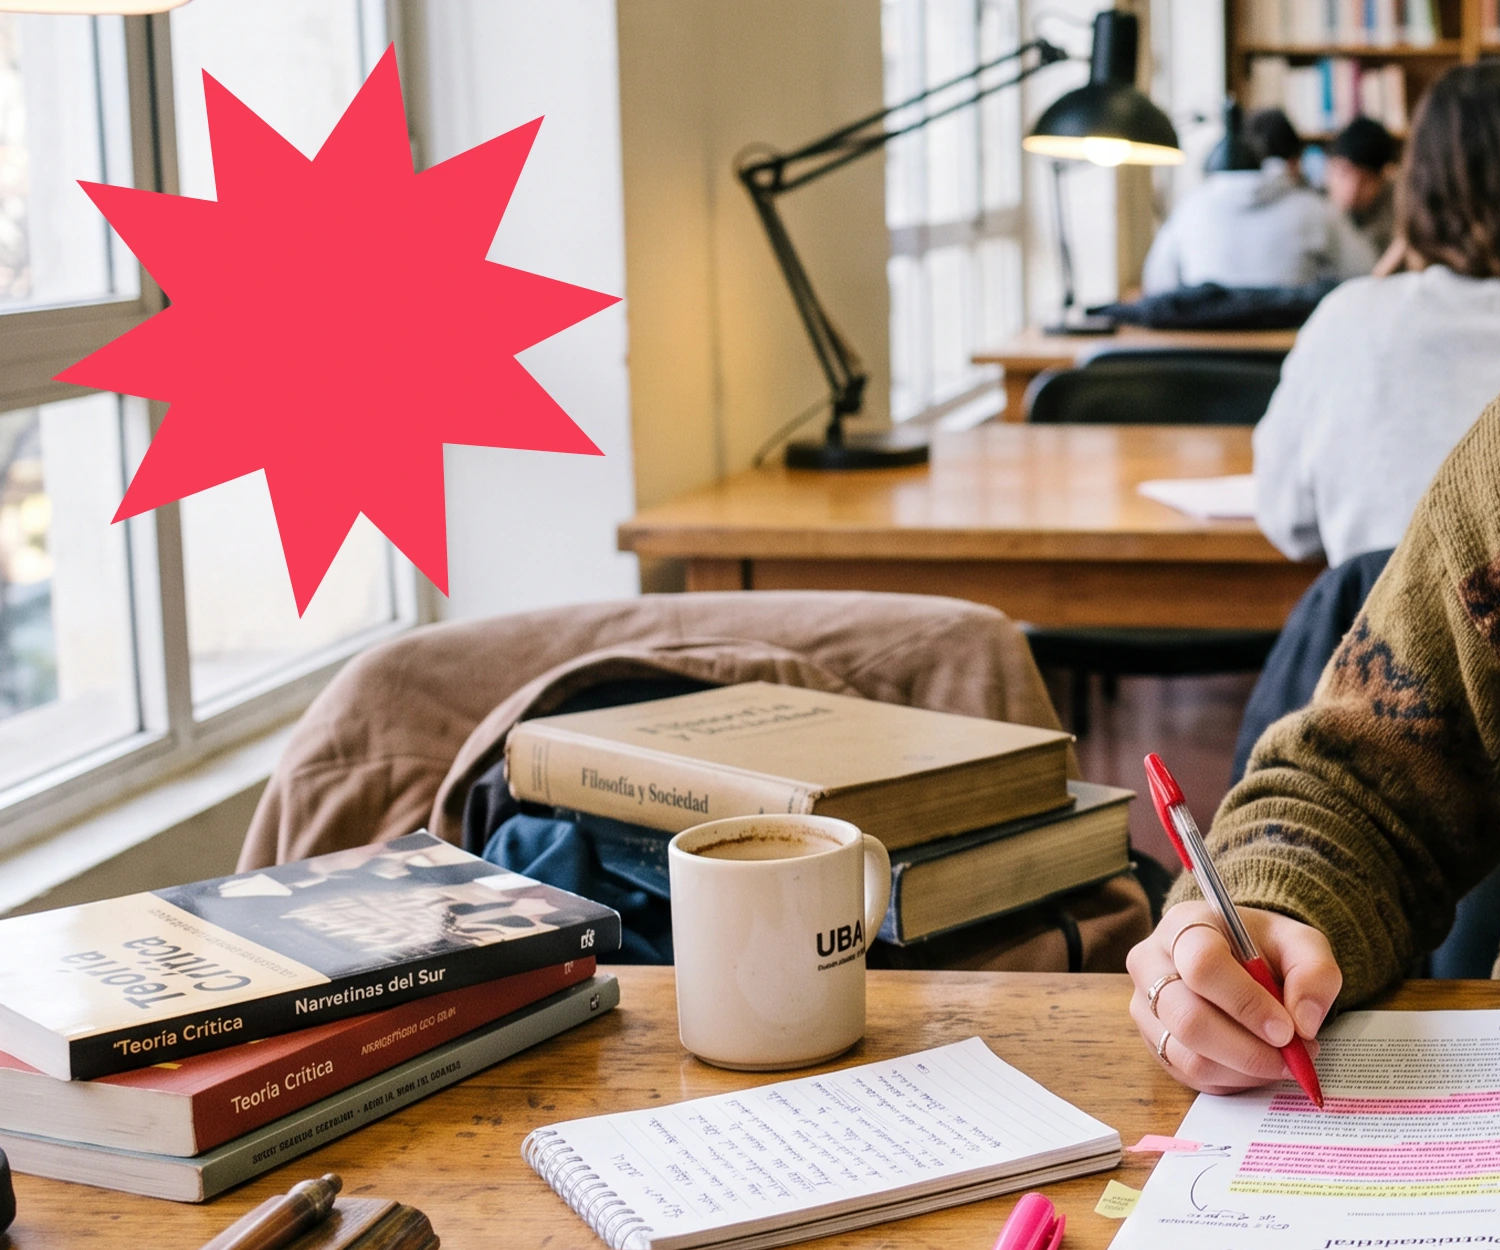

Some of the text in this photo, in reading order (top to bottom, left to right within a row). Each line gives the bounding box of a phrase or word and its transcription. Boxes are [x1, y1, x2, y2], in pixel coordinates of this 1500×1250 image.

[581, 767, 709, 814] Filosofía y Sociedad
[816, 919, 863, 957] UBA
[183, 1015, 243, 1041] Crítica
[295, 983, 384, 1015] Narvetinas
[388, 972, 414, 993] del
[418, 967, 446, 986] Sur
[230, 1080, 280, 1115] Teoría
[284, 1059, 334, 1091] Crítica
